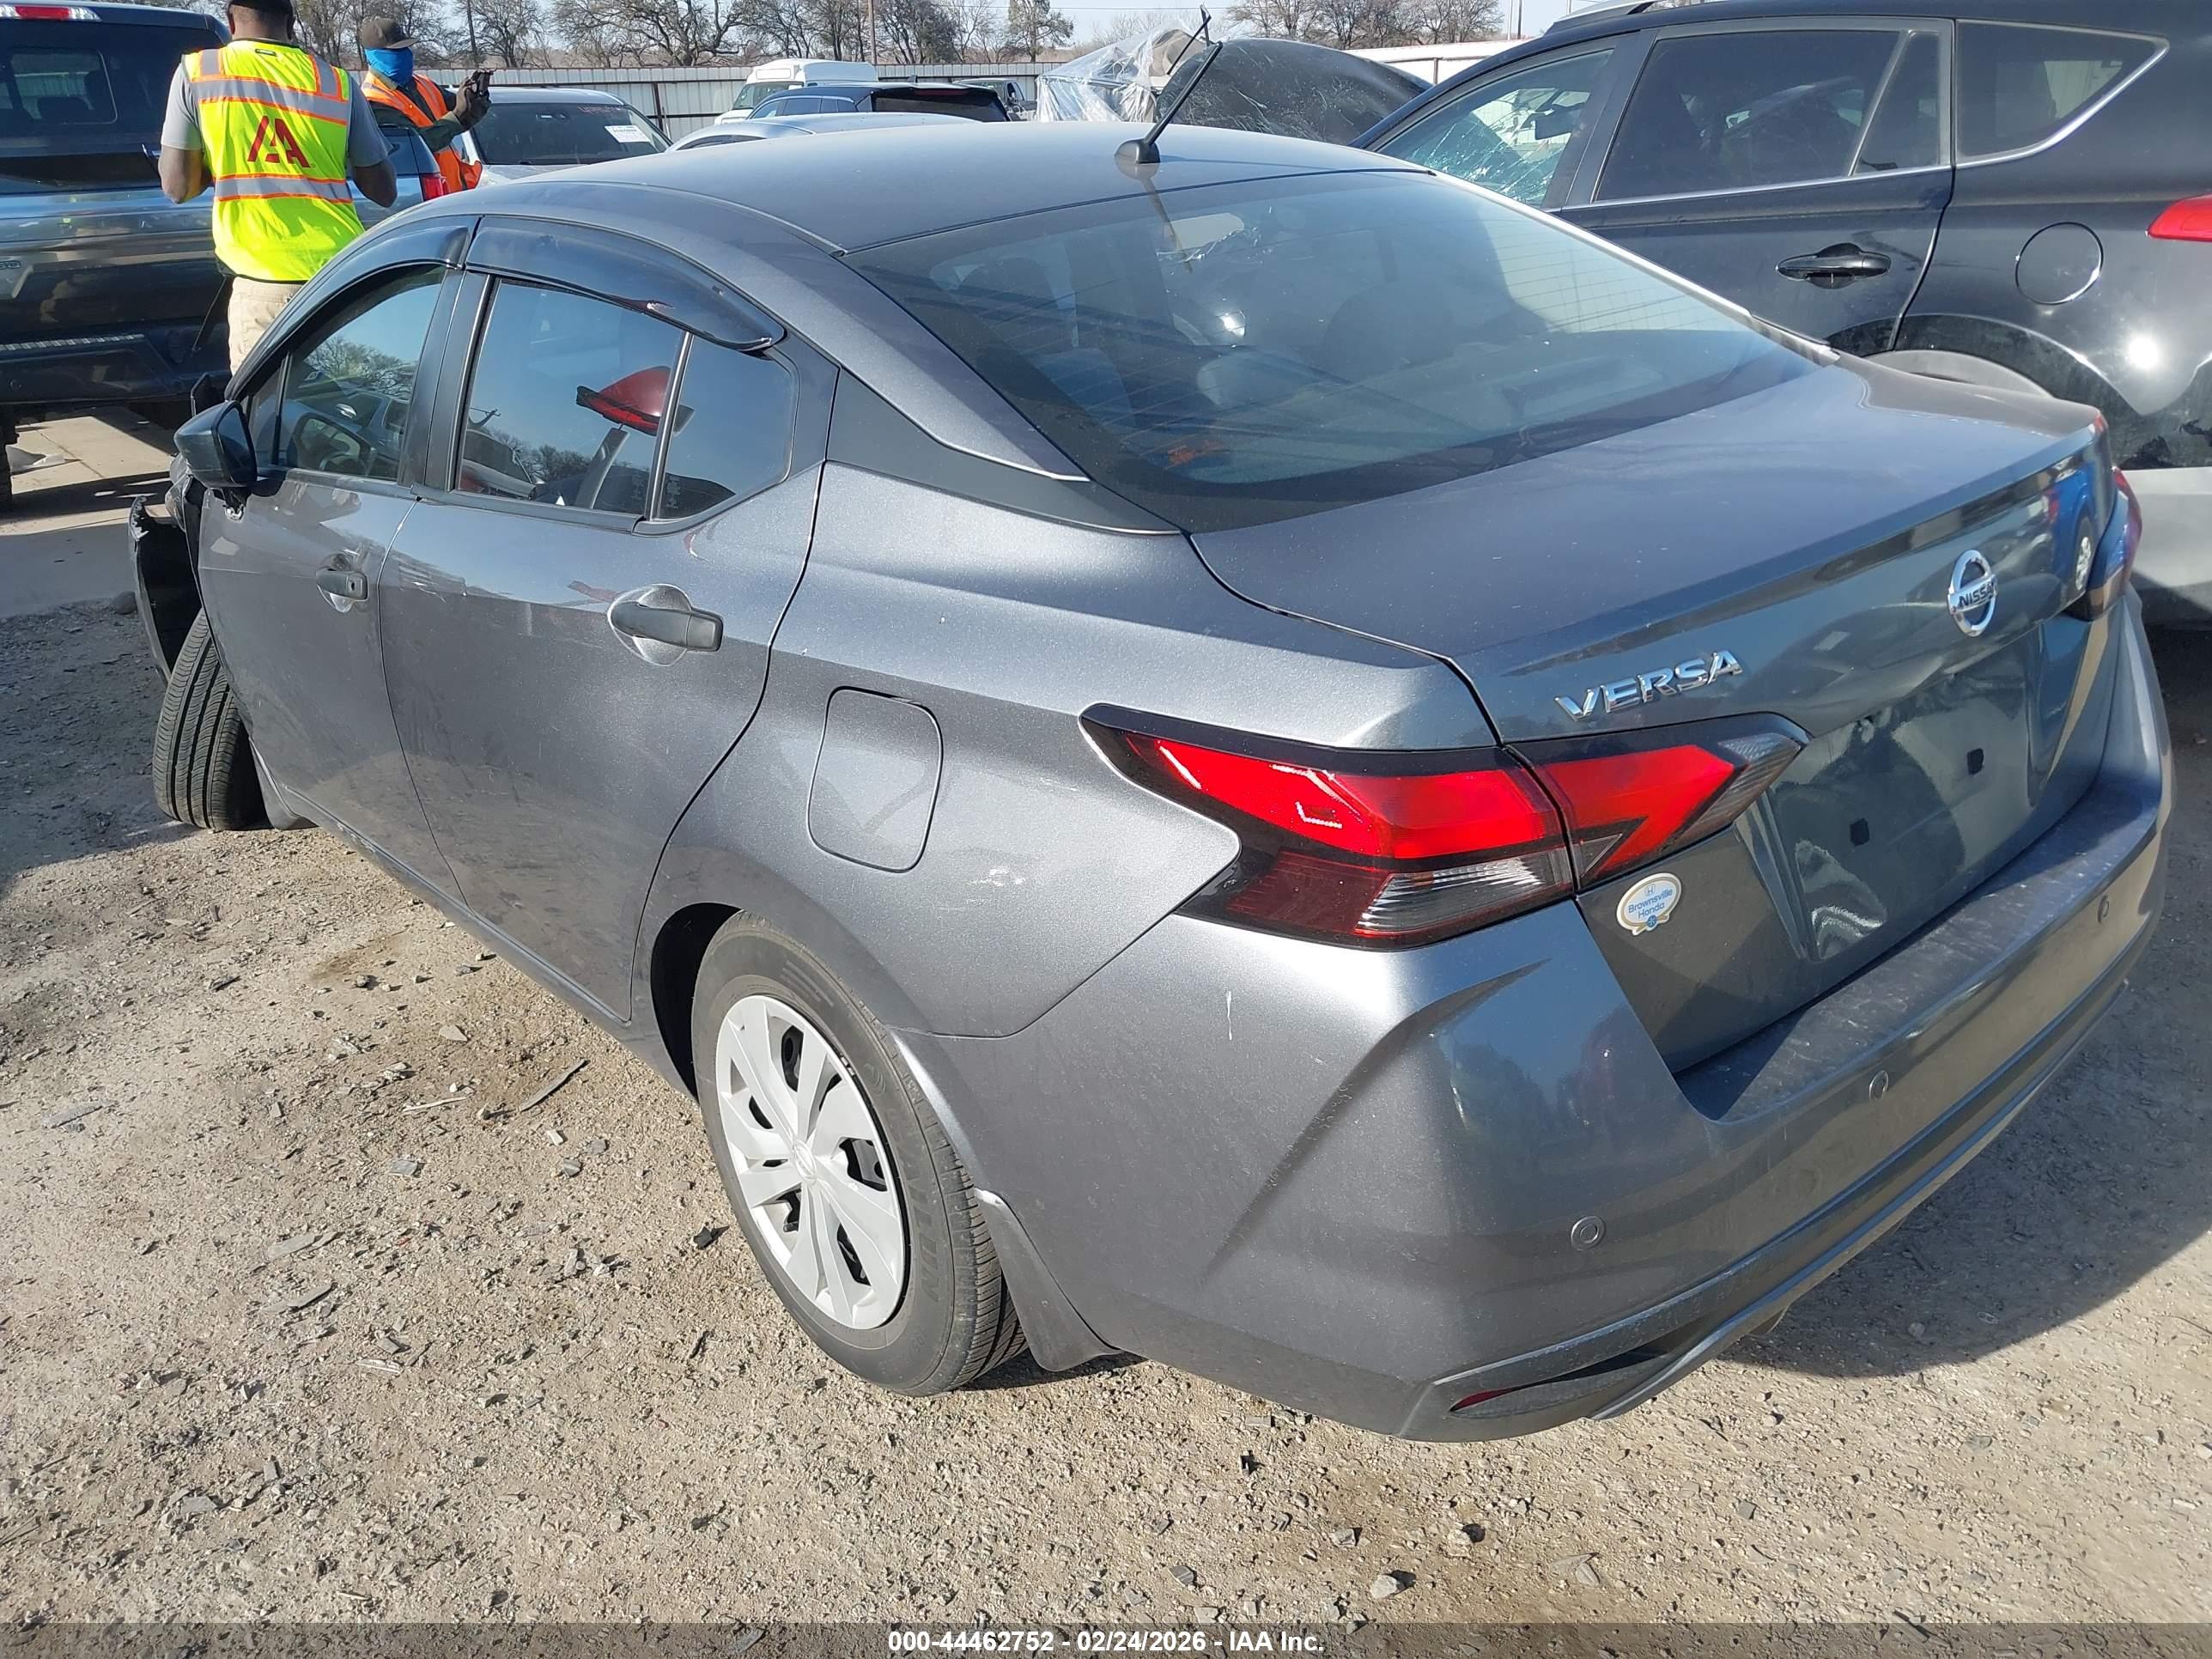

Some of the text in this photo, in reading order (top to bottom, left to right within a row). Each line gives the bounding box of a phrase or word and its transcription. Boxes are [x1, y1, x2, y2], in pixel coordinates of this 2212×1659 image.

[1553, 649, 1743, 721] VERSA
[1629, 889, 1673, 913] Brownsville
[1638, 902, 1665, 918] Honda
